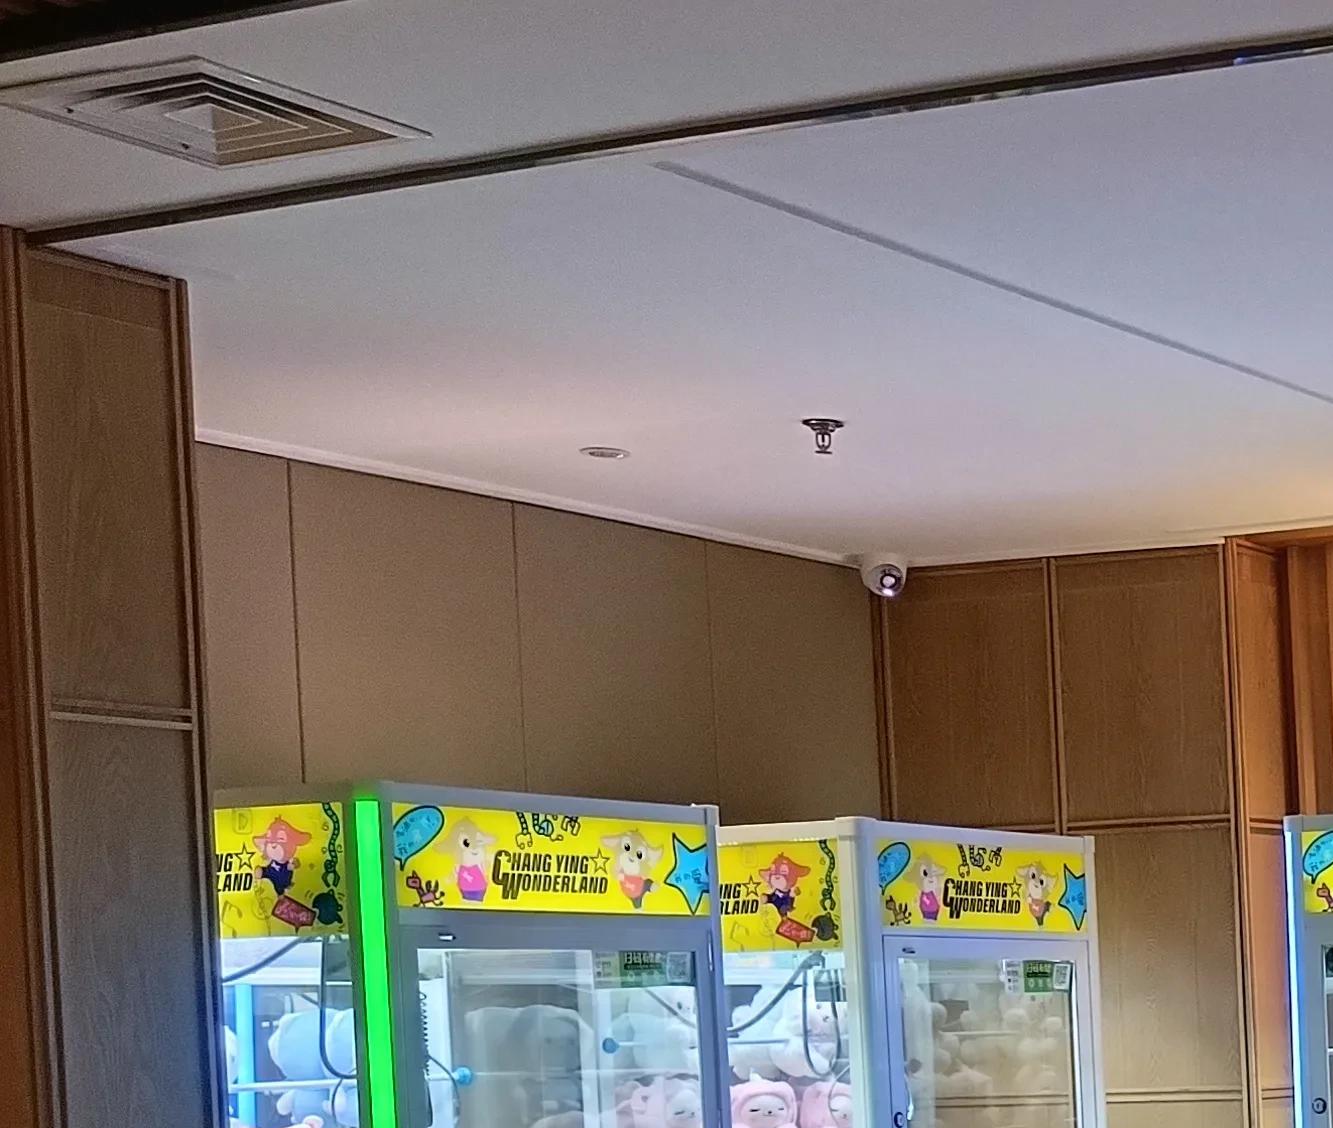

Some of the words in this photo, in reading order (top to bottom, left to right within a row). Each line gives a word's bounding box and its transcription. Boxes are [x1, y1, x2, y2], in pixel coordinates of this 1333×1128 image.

[492, 850, 552, 885] CHANG
[556, 856, 589, 874] YING
[502, 873, 608, 900] WONDERLAND
[943, 878, 983, 907] CHANG
[985, 882, 1008, 897] YING
[949, 896, 1021, 919] WONDERLAND
